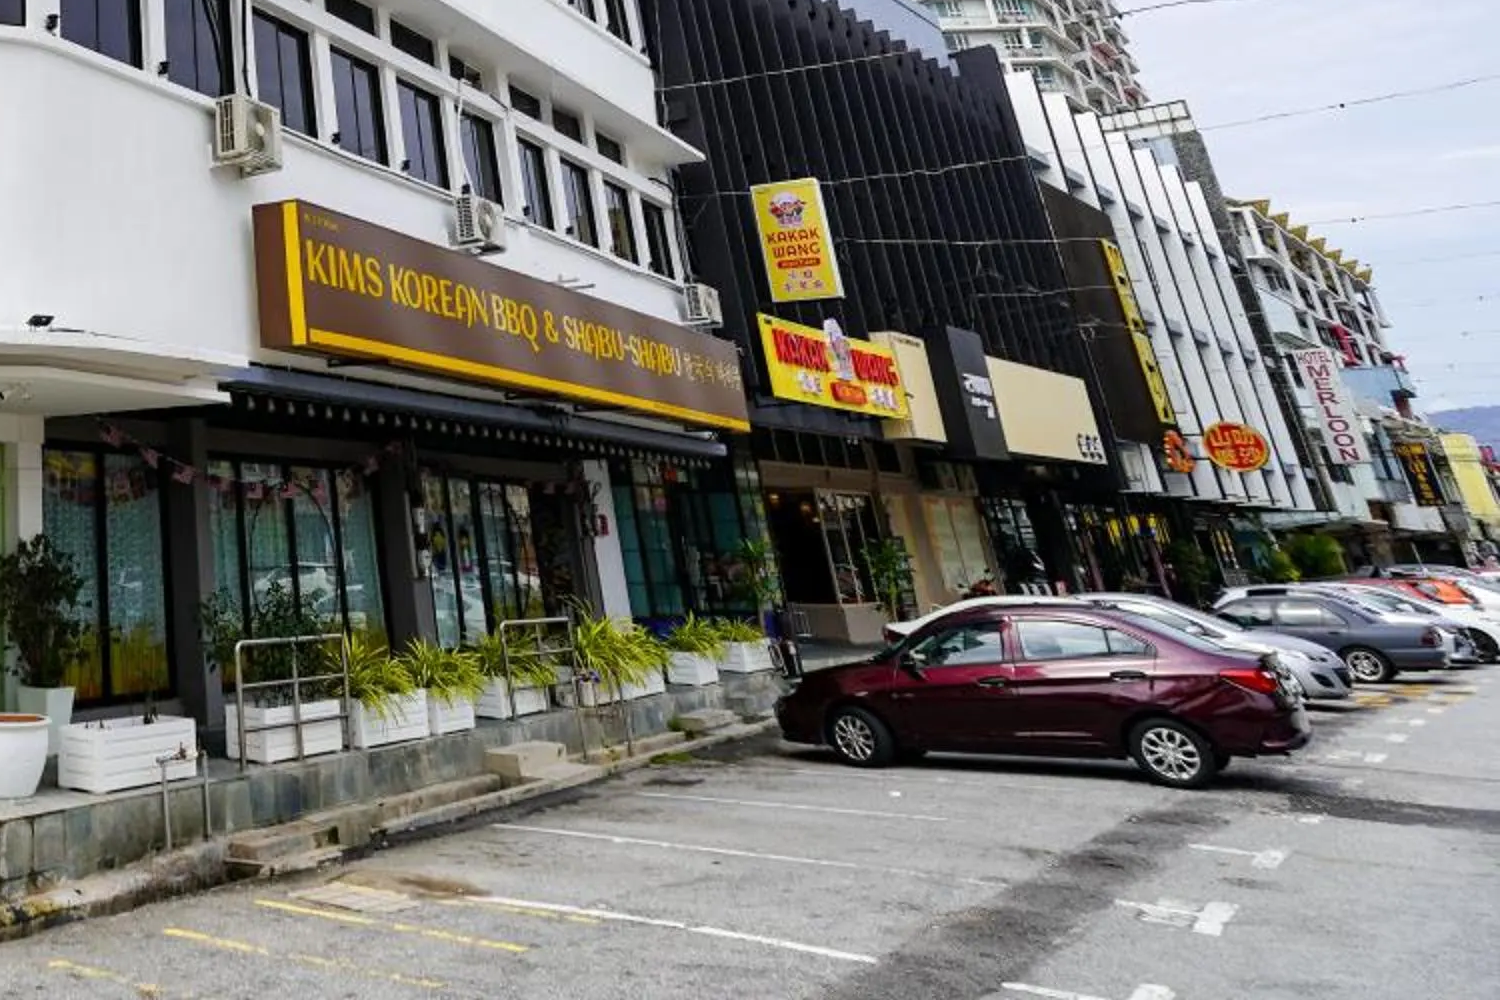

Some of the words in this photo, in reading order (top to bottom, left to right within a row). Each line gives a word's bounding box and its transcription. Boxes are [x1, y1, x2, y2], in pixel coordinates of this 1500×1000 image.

[766, 228, 819, 243] KAKAK
[772, 242, 820, 258] WANG
[305, 238, 385, 298] KIMS
[388, 262, 490, 329] KOREAN
[490, 293, 540, 353] BBQ
[543, 310, 559, 344] &
[562, 314, 681, 378] SHABU-SHABU
